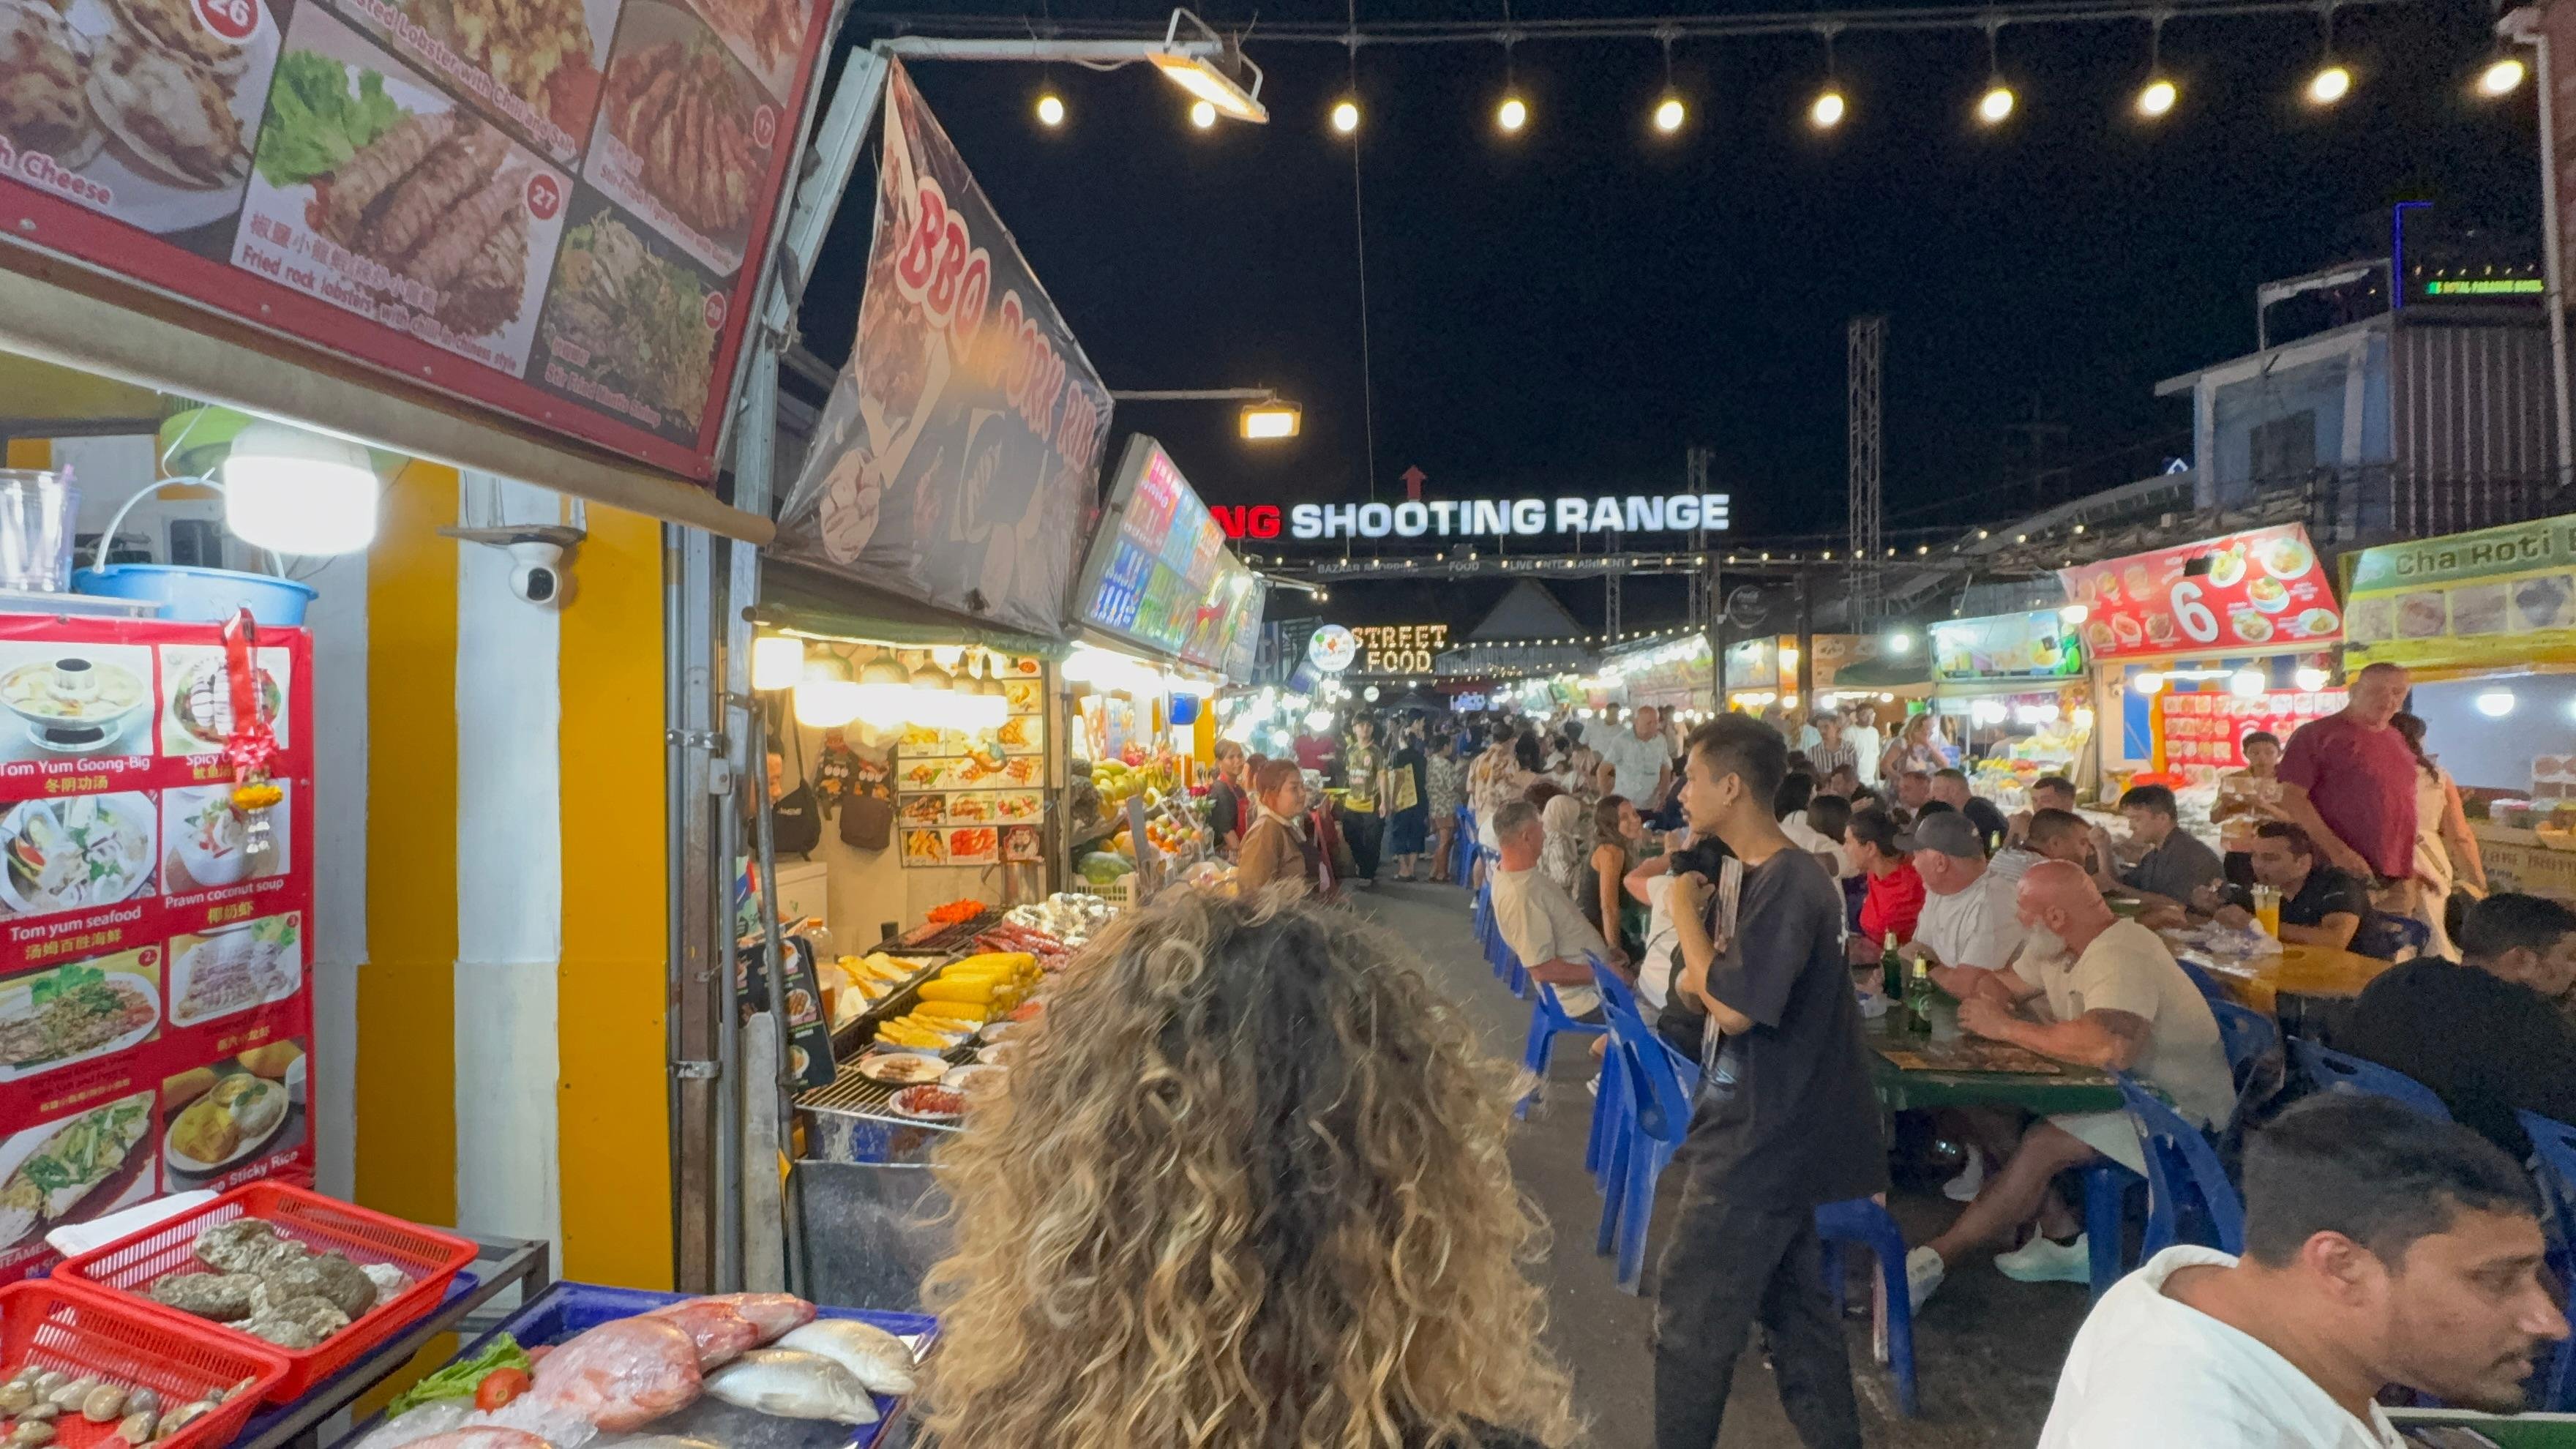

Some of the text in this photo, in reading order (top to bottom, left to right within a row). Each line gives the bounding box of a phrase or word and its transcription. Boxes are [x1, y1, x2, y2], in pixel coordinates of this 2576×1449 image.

[23, 154, 111, 206] Cheese
[533, 184, 556, 210] 27
[242, 244, 282, 276] Fried
[897, 180, 989, 360] BBQ
[1291, 500, 1547, 539] SHOOTING
[1556, 494, 1730, 533] RANGE
[1448, 561, 1480, 572] FOOD
[1510, 560, 1533, 571] LIVE
[2395, 549, 2457, 576] Cha
[2471, 529, 2551, 564] Roti
[2170, 581, 2219, 643] 6
[1351, 624, 1448, 649] STREET
[1367, 650, 1432, 673] FOOD
[0, 756, 151, 776] Tom Yum Goong-Big
[186, 755, 220, 767] Spicy
[165, 878, 284, 909] Prawn coconut soup
[10, 906, 142, 941] Tom yum seafood
[229, 1161, 268, 1186] Sticky
[271, 1151, 299, 1169] Rice
